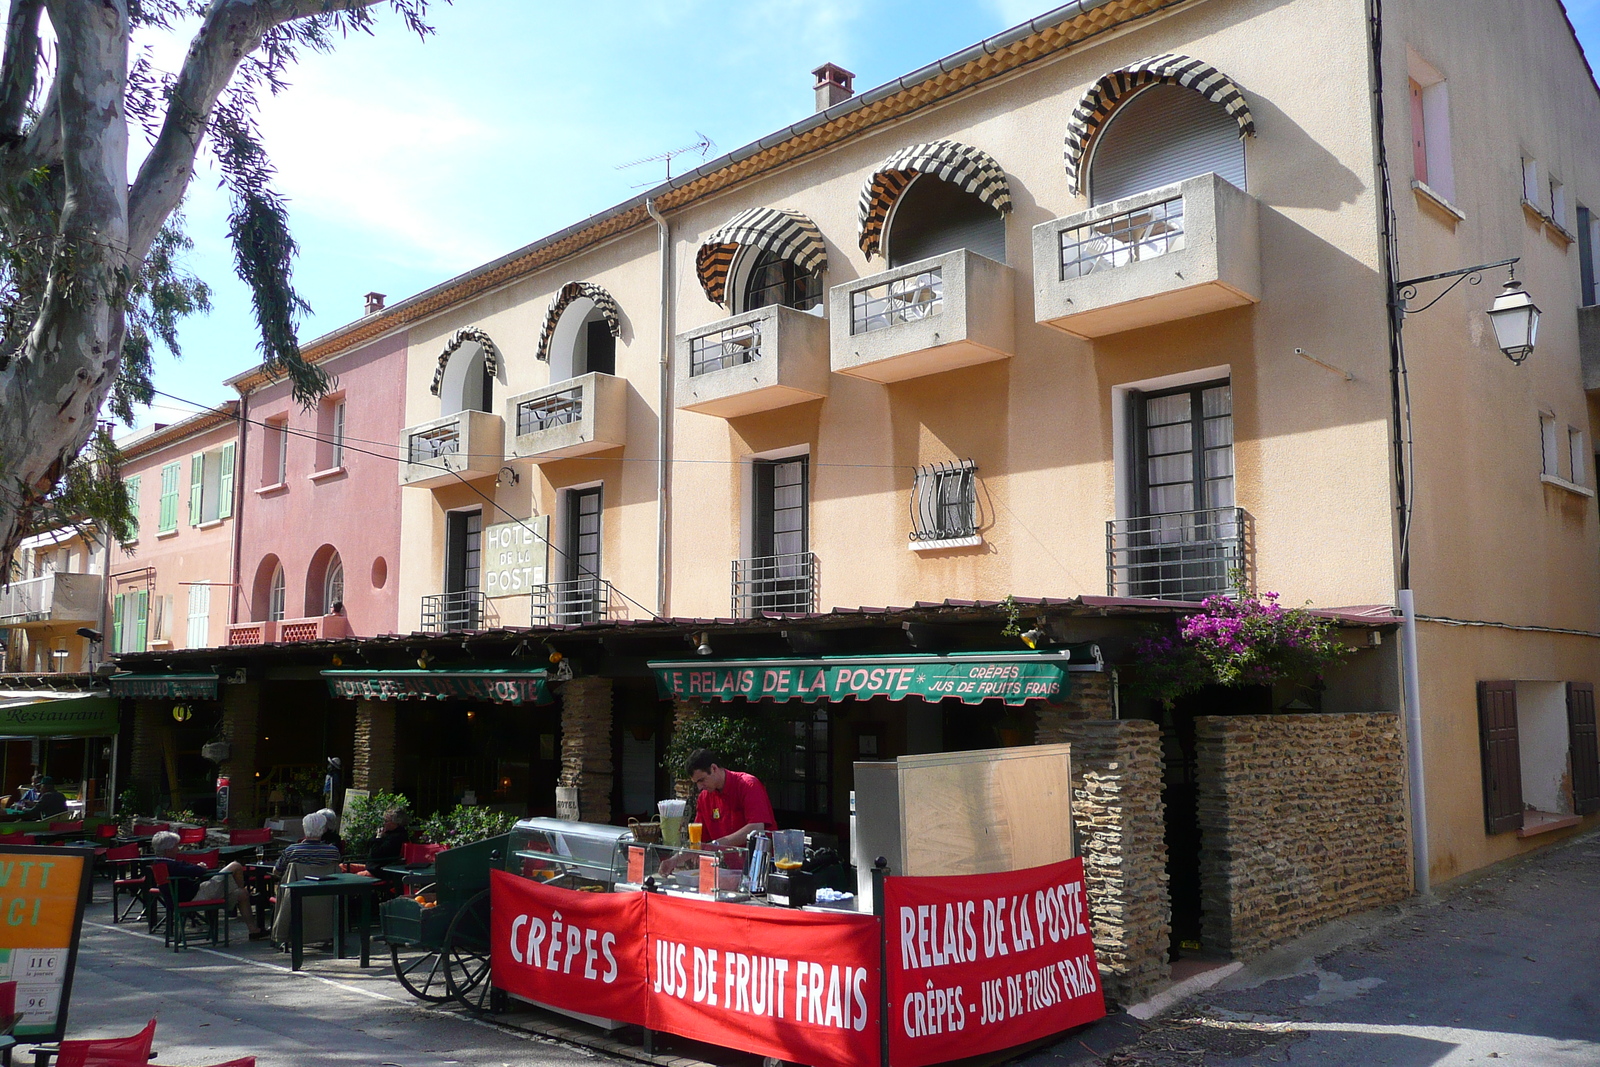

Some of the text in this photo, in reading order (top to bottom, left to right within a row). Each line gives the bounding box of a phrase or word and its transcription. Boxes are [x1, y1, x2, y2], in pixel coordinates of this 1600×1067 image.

[488, 521, 545, 549] HOTEL
[500, 549, 531, 565] DE LA
[486, 566, 544, 593] POSTE
[690, 670, 754, 693] RELAIS
[762, 669, 791, 692] DE
[797, 670, 826, 693] LA
[834, 667, 915, 692] POSTE
[969, 665, 1020, 679] CRÊPES
[486, 680, 538, 699] POSTE
[928, 681, 1060, 694] JUS DE FRUITS FRAIS
[6, 708, 106, 724] Restaurant
[900, 880, 1087, 970] RELAIS DE LA POSTE
[510, 909, 618, 984] CRÊPES
[30, 957, 55, 968] 11 €
[654, 939, 868, 1032] JUS DE FRUIT FRAIS
[903, 978, 965, 1038] CRÊPES
[980, 978, 1005, 1026] JUS
[1006, 973, 1024, 1018] DE
[1025, 963, 1062, 1013] FRUIT
[1057, 953, 1097, 1000] FRAIS
[29, 998, 45, 1008] 9 €
